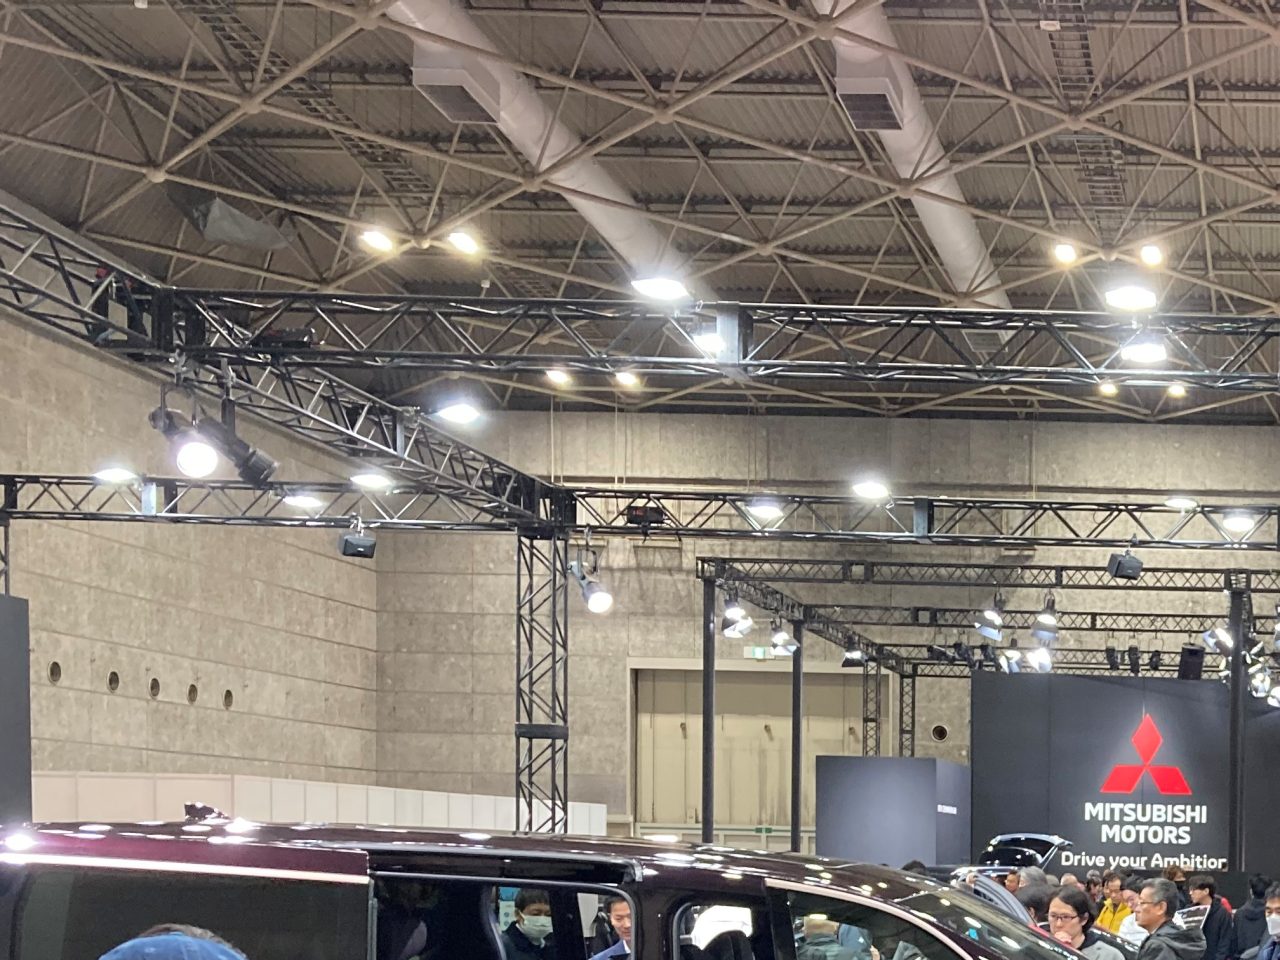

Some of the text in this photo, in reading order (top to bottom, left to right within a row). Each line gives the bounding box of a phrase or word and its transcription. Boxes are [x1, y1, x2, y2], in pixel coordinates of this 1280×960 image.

[1084, 802, 1208, 823] MITSUBISHI
[1101, 824, 1192, 845] MOTORS
[1061, 851, 1106, 867] Drive
[1105, 854, 1148, 870] your
